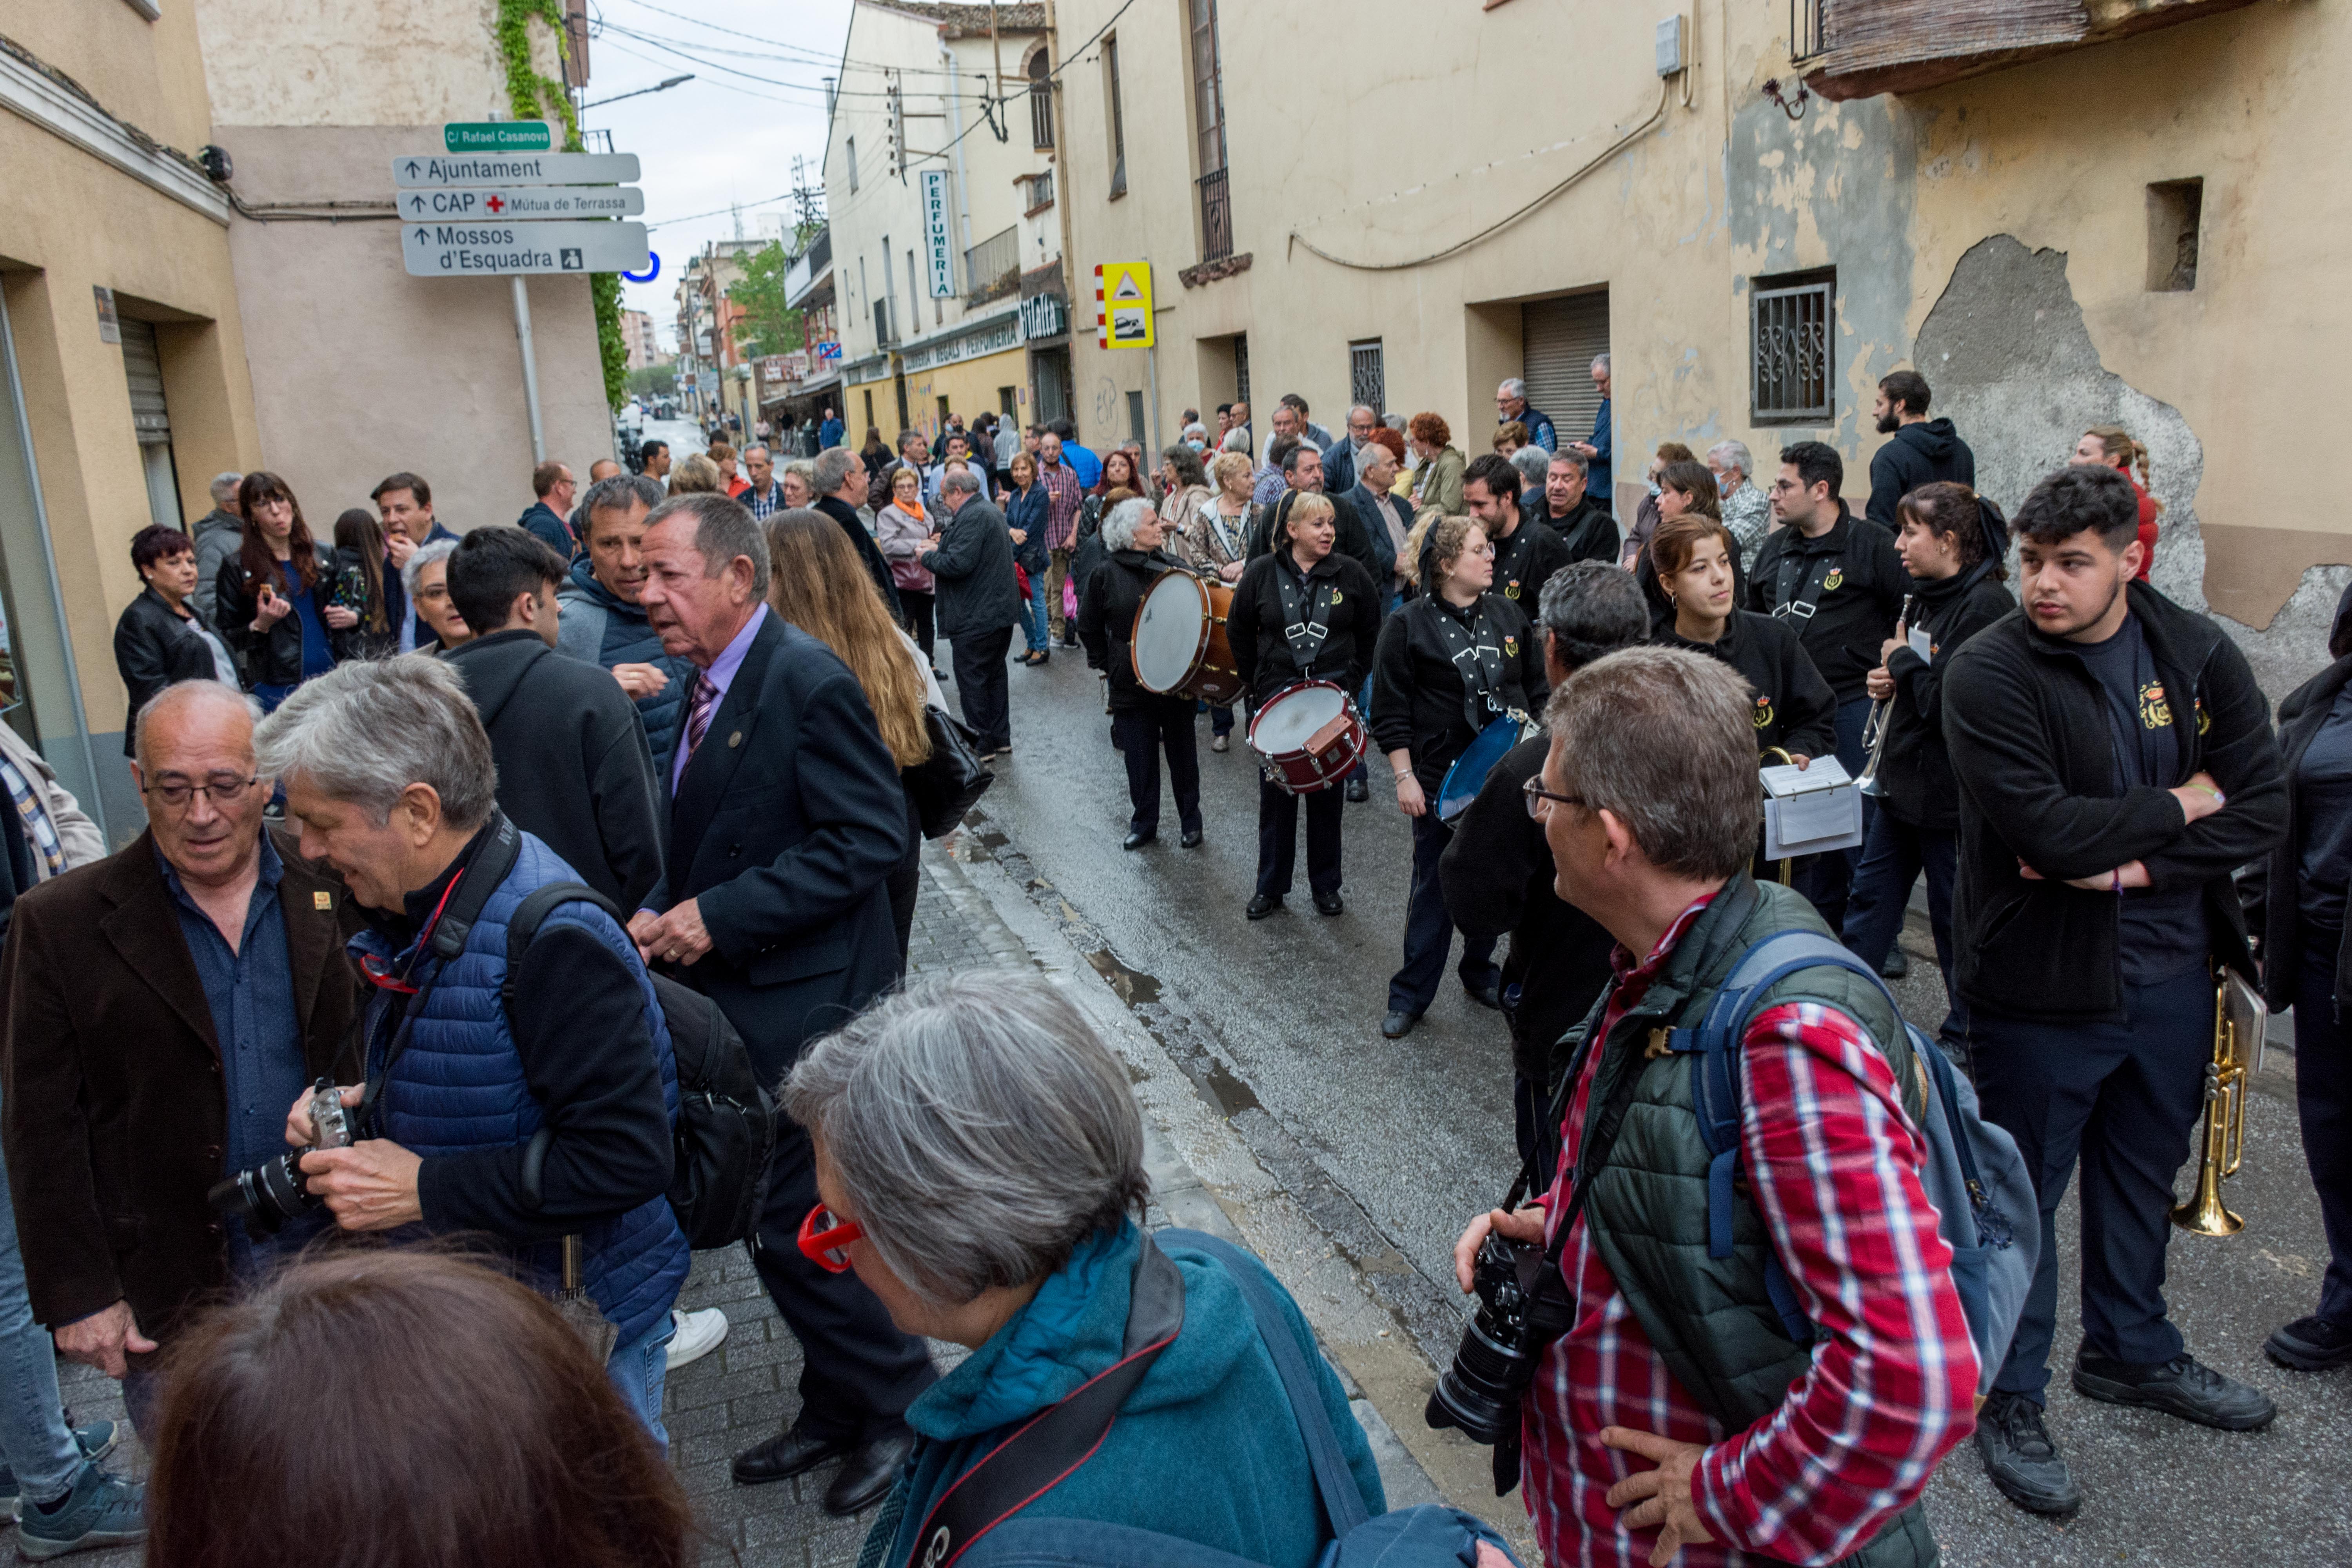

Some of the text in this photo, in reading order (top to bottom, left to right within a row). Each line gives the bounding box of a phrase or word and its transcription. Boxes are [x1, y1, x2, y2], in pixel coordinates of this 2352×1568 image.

[447, 130, 548, 143] C/ Rafael Casanova
[429, 159, 542, 183] Ajuntament
[433, 193, 475, 213] CAP
[511, 196, 626, 211] Mútua de Terrassa
[437, 226, 513, 245] Mossos
[929, 175, 949, 294] PERFUMERIA
[440, 249, 553, 272] d'Esquadra
[966, 321, 1017, 356] PERFUMERIA
